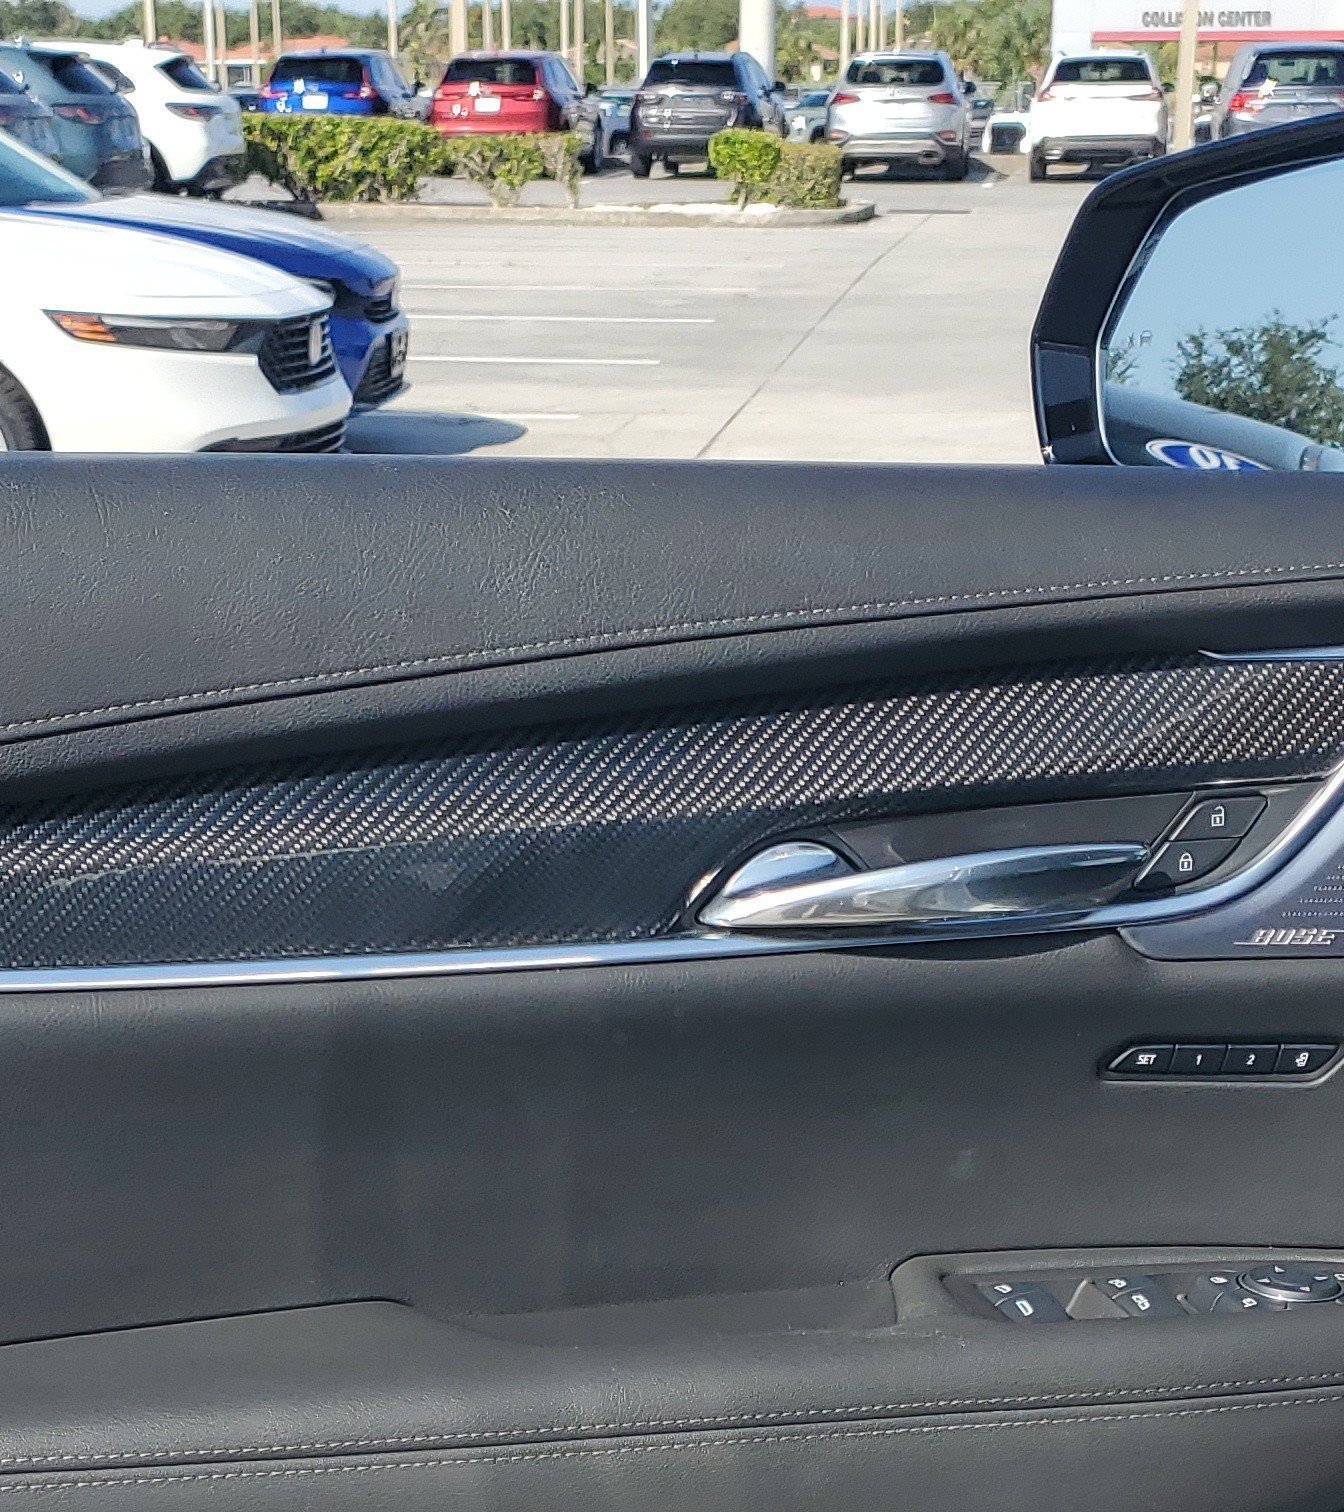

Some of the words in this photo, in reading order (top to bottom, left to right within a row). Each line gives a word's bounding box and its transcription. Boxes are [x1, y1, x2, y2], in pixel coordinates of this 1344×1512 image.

[1142, 11, 1214, 27] COLLION
[1218, 11, 1272, 27] CENTER
[1135, 1054, 1156, 1065] SET
[1195, 1054, 1203, 1066] 1
[1246, 1054, 1256, 1065] 2
